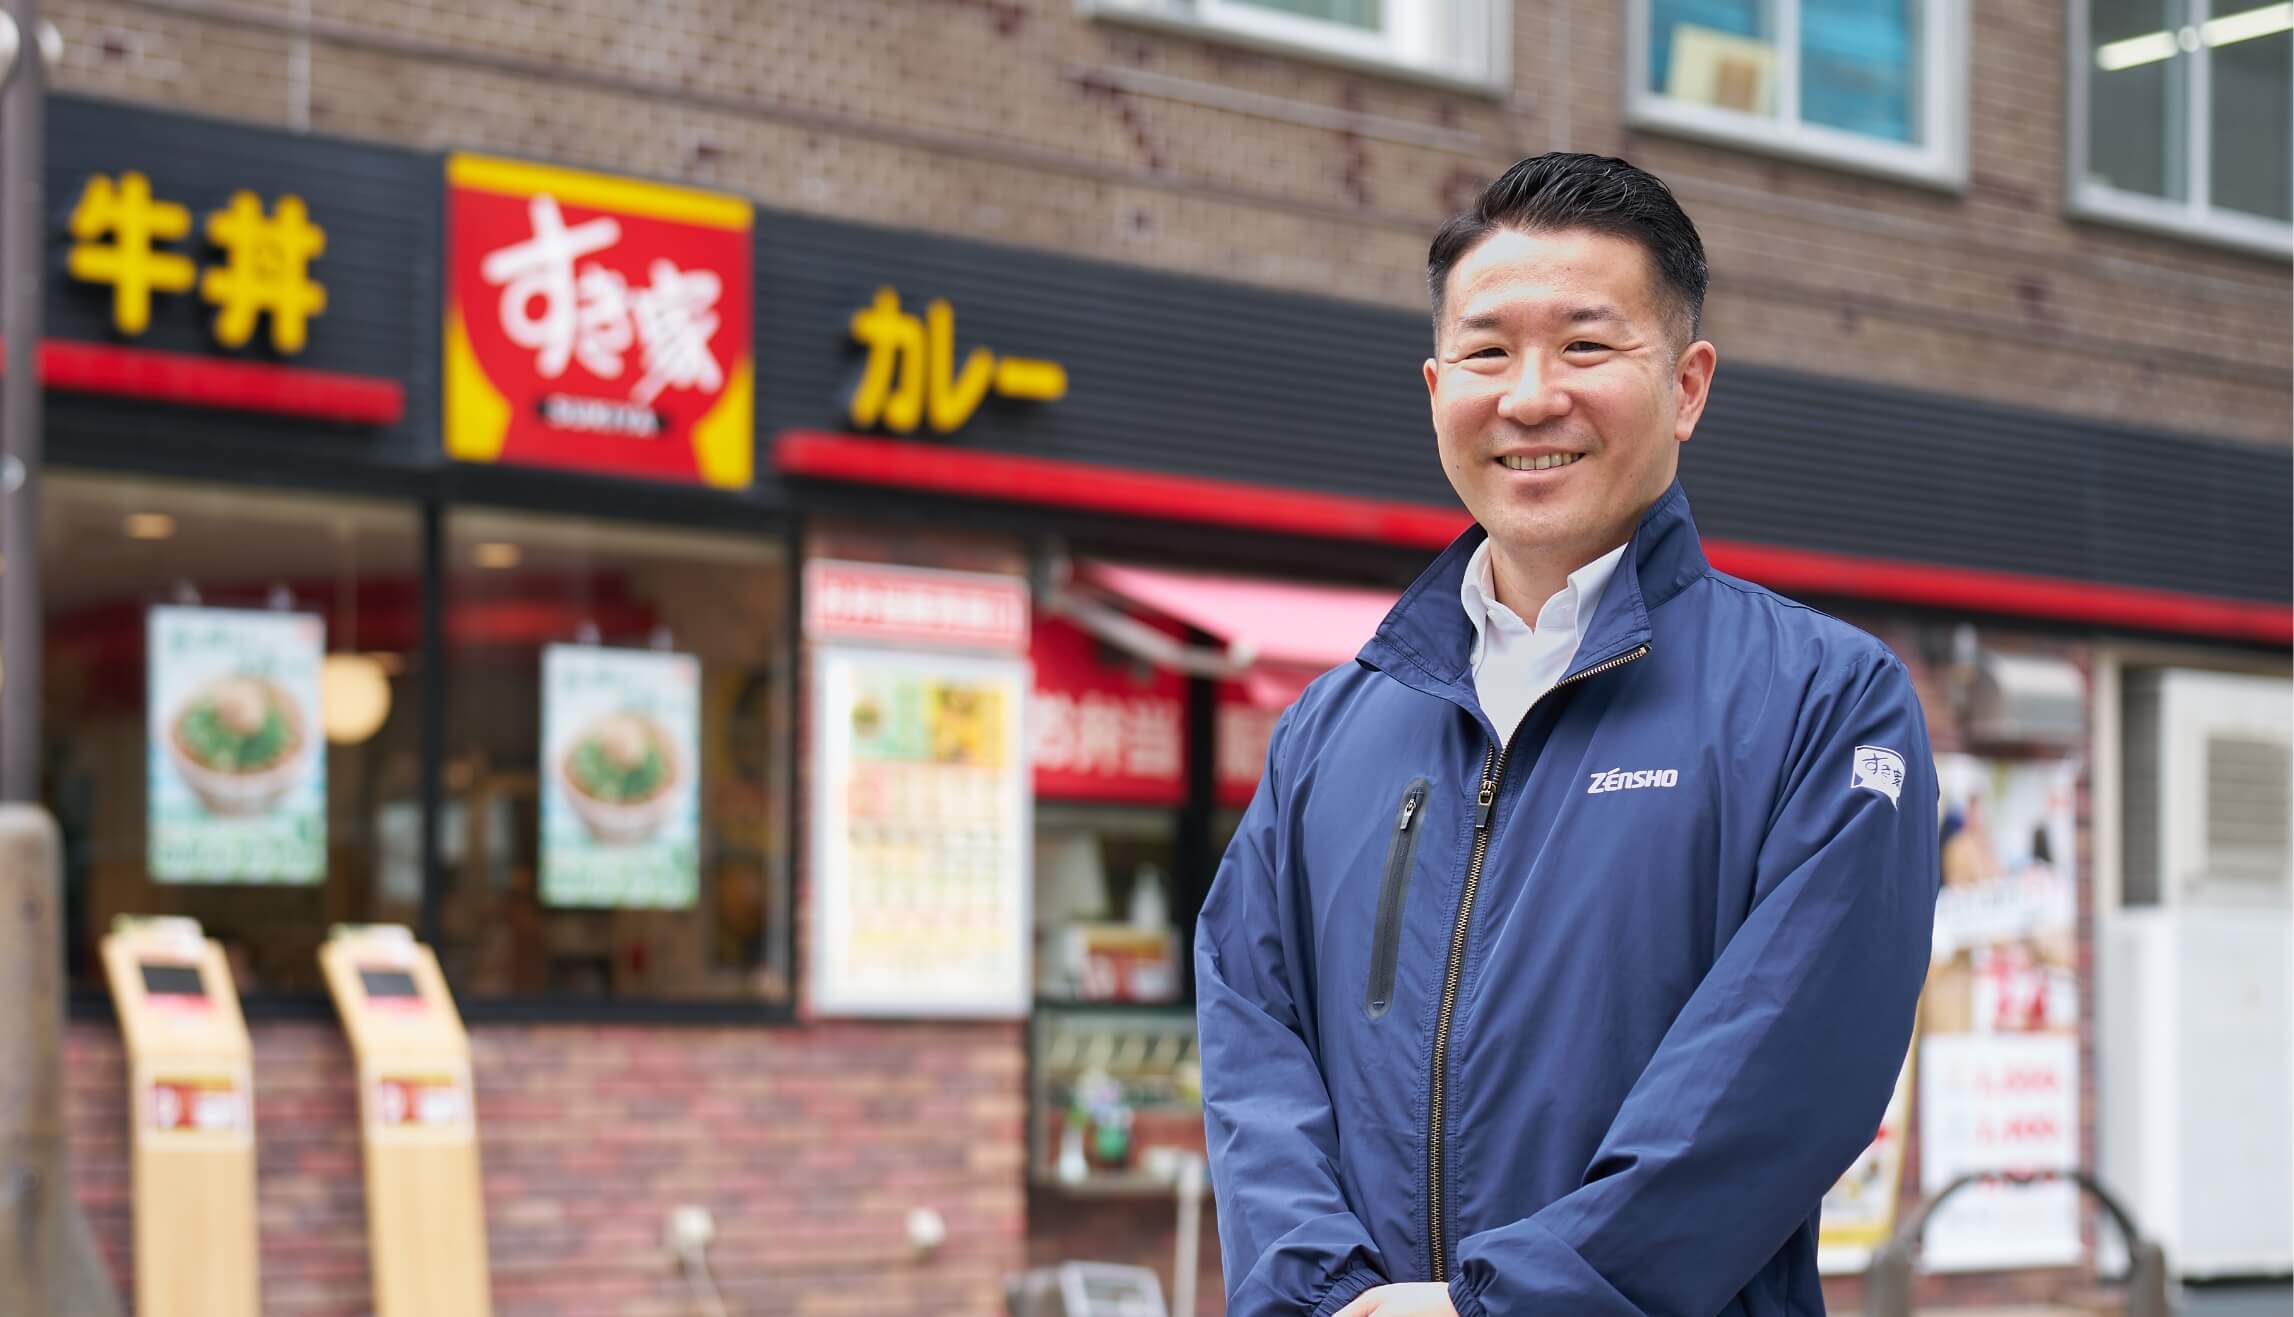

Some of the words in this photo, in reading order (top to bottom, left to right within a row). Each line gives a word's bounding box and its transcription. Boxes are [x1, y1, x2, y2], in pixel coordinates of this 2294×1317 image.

[68, 171, 328, 354] 牛丼
[481, 193, 724, 405] すき家
[851, 285, 1068, 434] カレー
